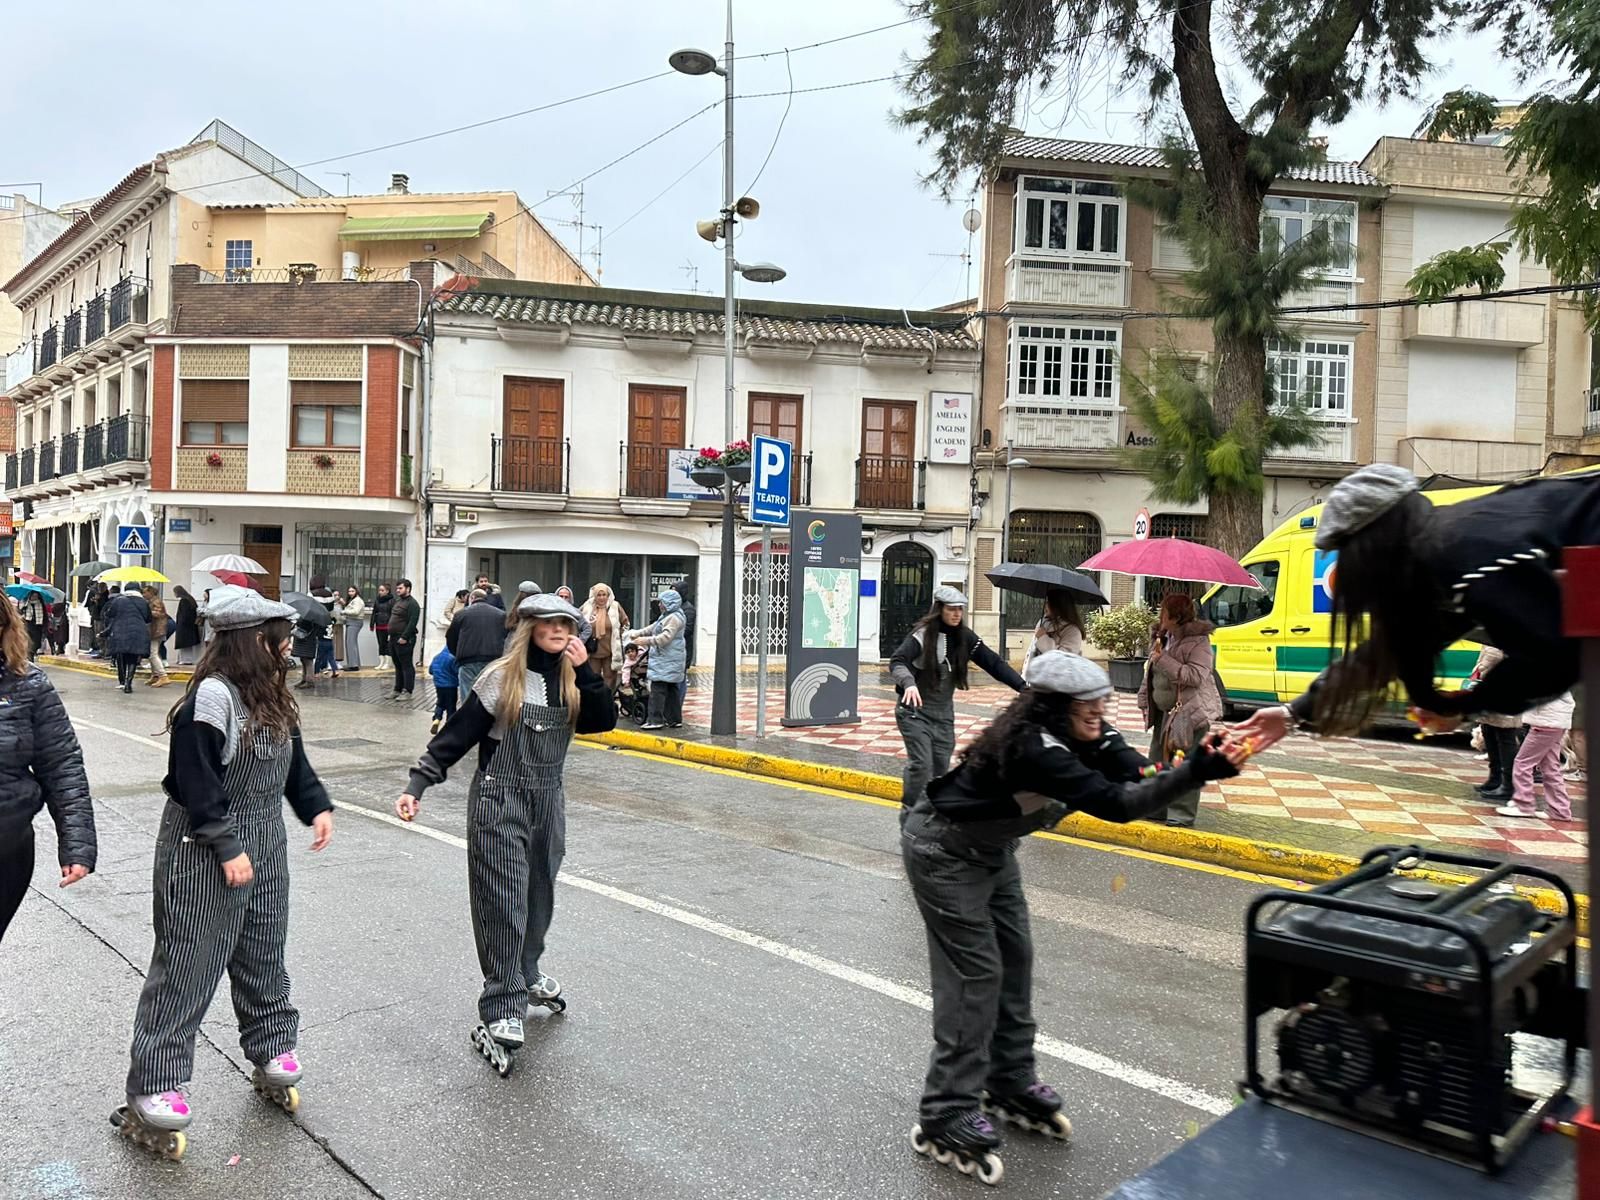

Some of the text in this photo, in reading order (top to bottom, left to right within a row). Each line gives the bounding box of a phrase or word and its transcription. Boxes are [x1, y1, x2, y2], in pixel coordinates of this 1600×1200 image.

[936, 411, 967, 419] AMELIA'S
[936, 425, 965, 433] ENGLISH
[935, 438, 966, 446] ACADEMY
[760, 442, 785, 490] P
[756, 492, 786, 505] TEATRO
[1136, 520, 1146, 534] 20
